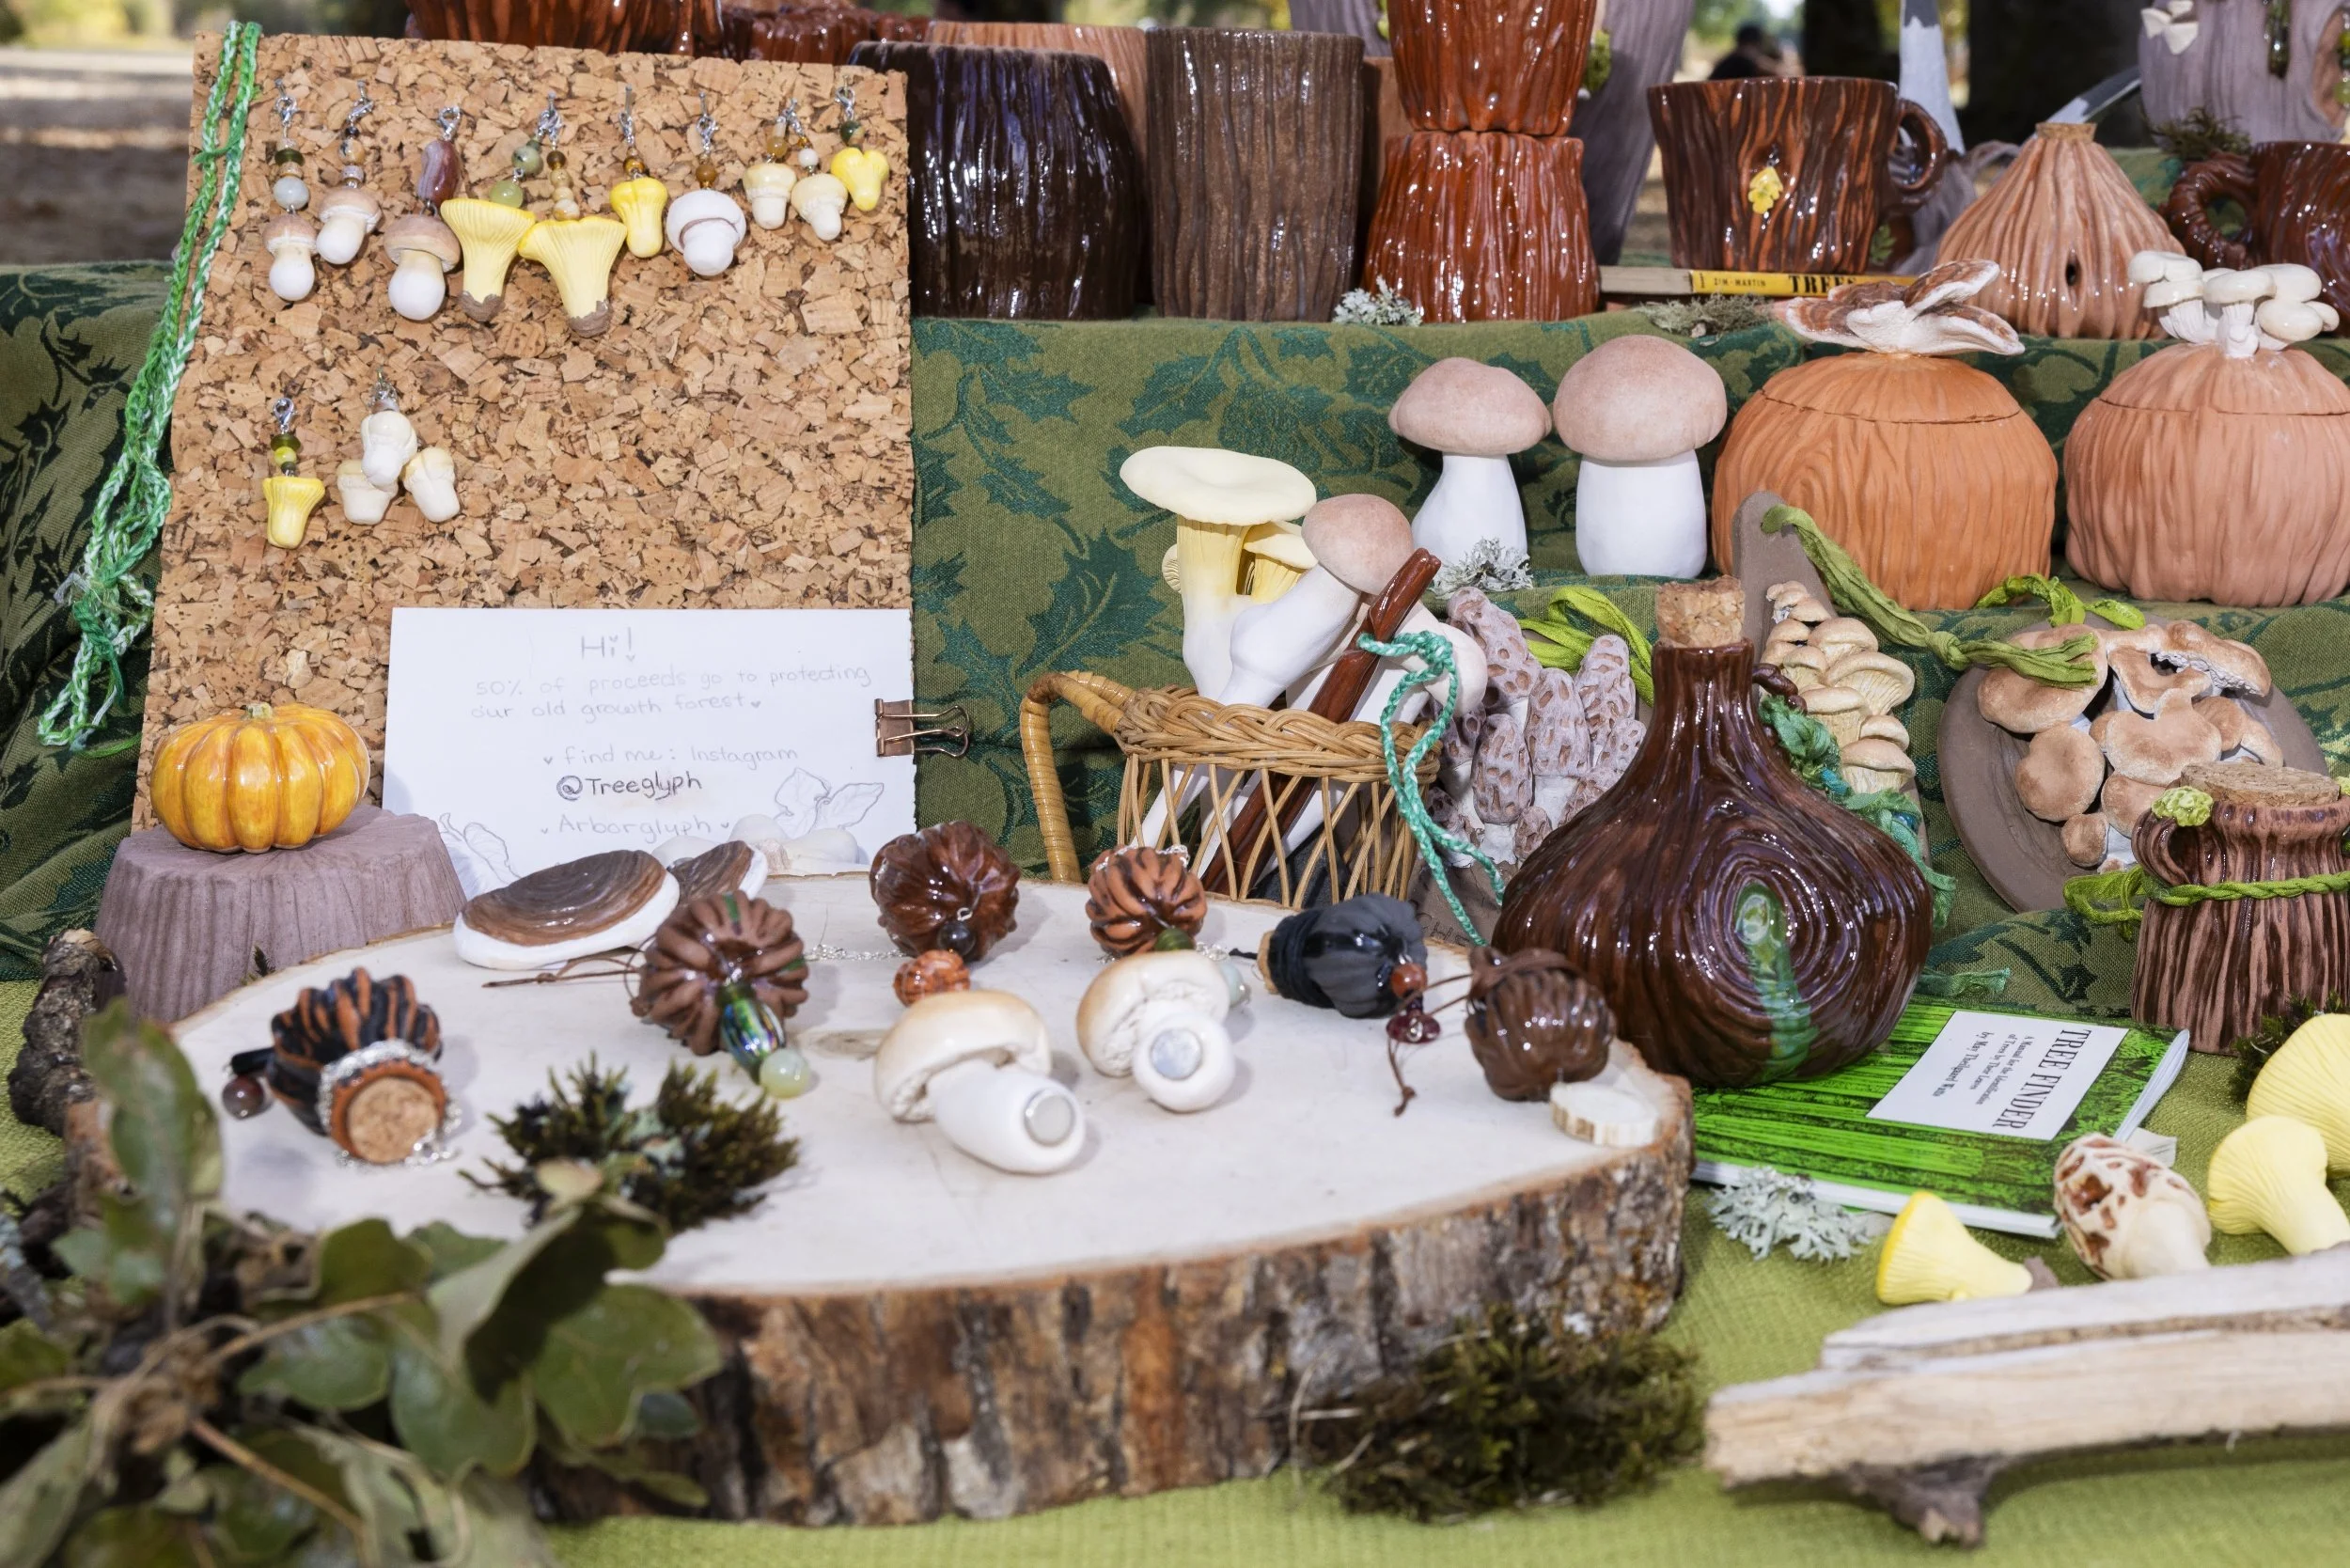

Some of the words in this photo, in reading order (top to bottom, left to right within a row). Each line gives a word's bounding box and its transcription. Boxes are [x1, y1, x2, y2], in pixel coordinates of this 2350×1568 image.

[581, 627, 635, 662] Hi!
[477, 679, 523, 697] 50%
[540, 677, 565, 693] of
[589, 663, 686, 697] proceeds
[701, 672, 722, 690] go
[737, 669, 758, 683] to
[770, 664, 872, 688] protecting
[471, 705, 514, 718] our
[531, 699, 565, 717] old
[581, 698, 662, 724] growth
[675, 692, 745, 711] forest
[691, 745, 798, 770] Instagram
[556, 770, 703, 801] @Treeglyph
[558, 814, 712, 844] Arborglyph
[1967, 1041, 1988, 1052] May
[1998, 1041, 2015, 1053] Trees
[2013, 1042, 2032, 1058] Manual
[2038, 1030, 2092, 1070] TREE
[1993, 1073, 2061, 1128] FINDER
